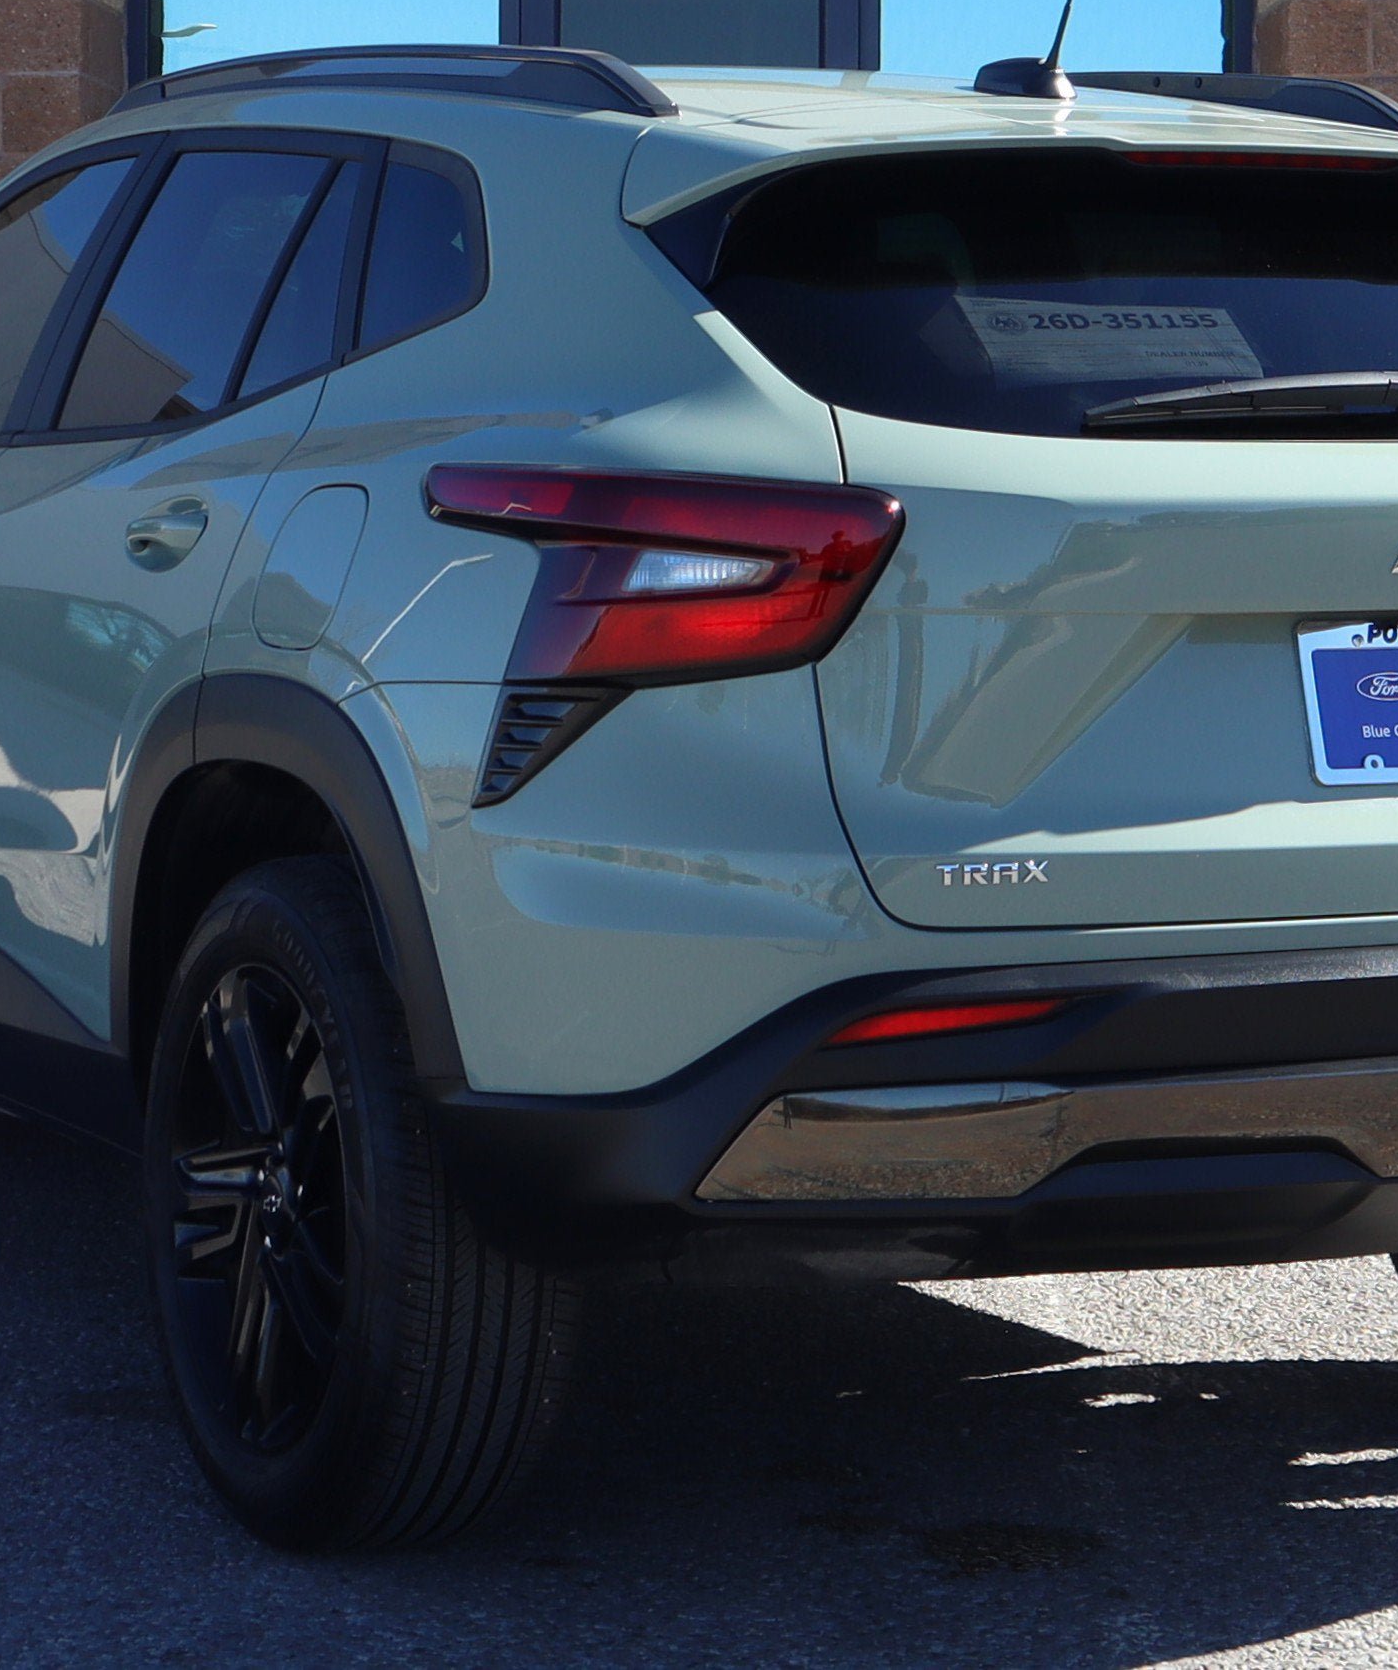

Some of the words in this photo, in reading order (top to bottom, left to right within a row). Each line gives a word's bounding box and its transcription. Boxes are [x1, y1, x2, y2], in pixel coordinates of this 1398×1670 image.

[1027, 313, 1219, 331] 26D-351155
[1362, 724, 1391, 739] Blue
[935, 860, 1049, 886] TRAX
